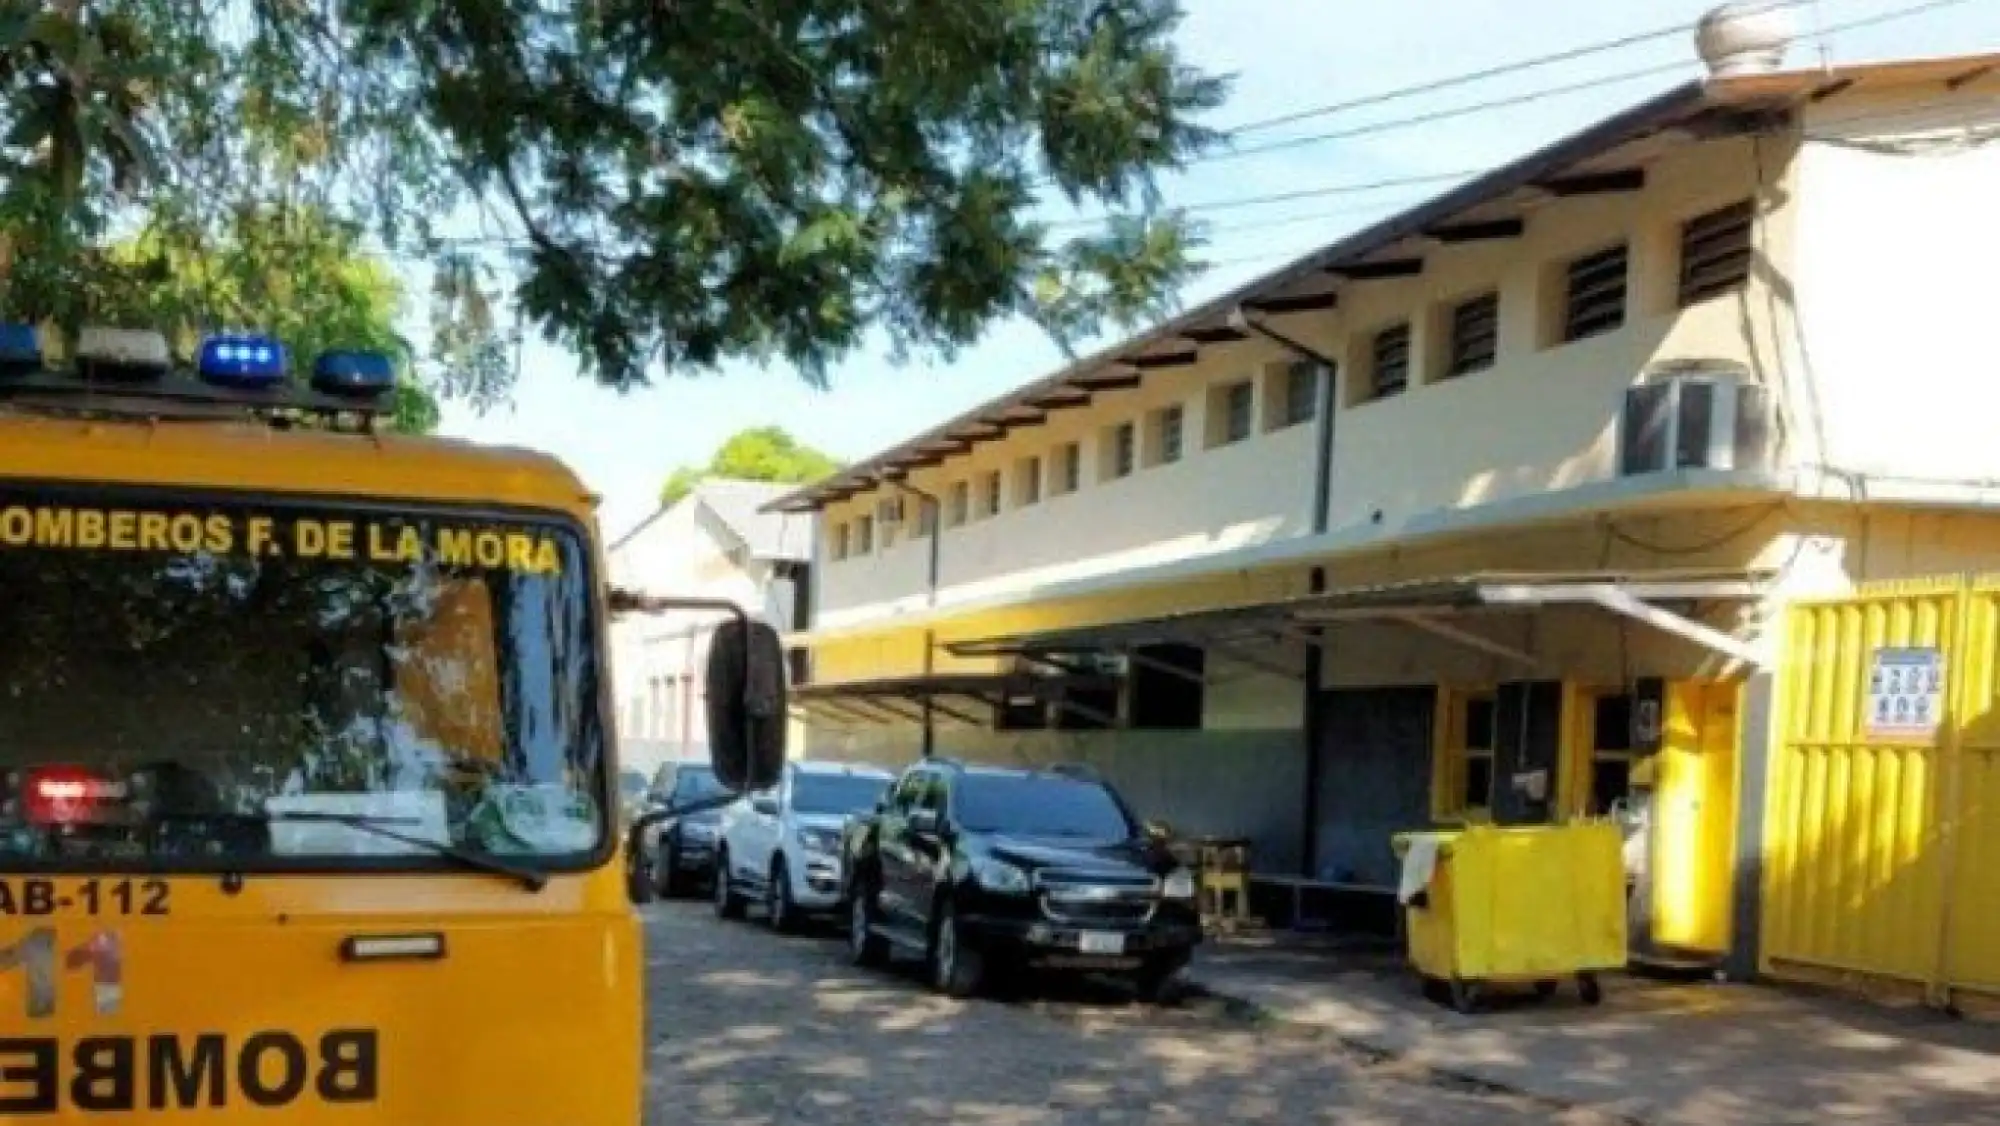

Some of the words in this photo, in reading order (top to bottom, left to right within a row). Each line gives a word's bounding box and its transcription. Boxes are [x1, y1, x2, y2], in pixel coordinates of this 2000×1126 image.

[1, 506, 233, 553] OMBEROS
[247, 516, 280, 556] F.
[297, 519, 354, 560] DE
[369, 522, 421, 562] LA
[438, 528, 561, 574] MORA
